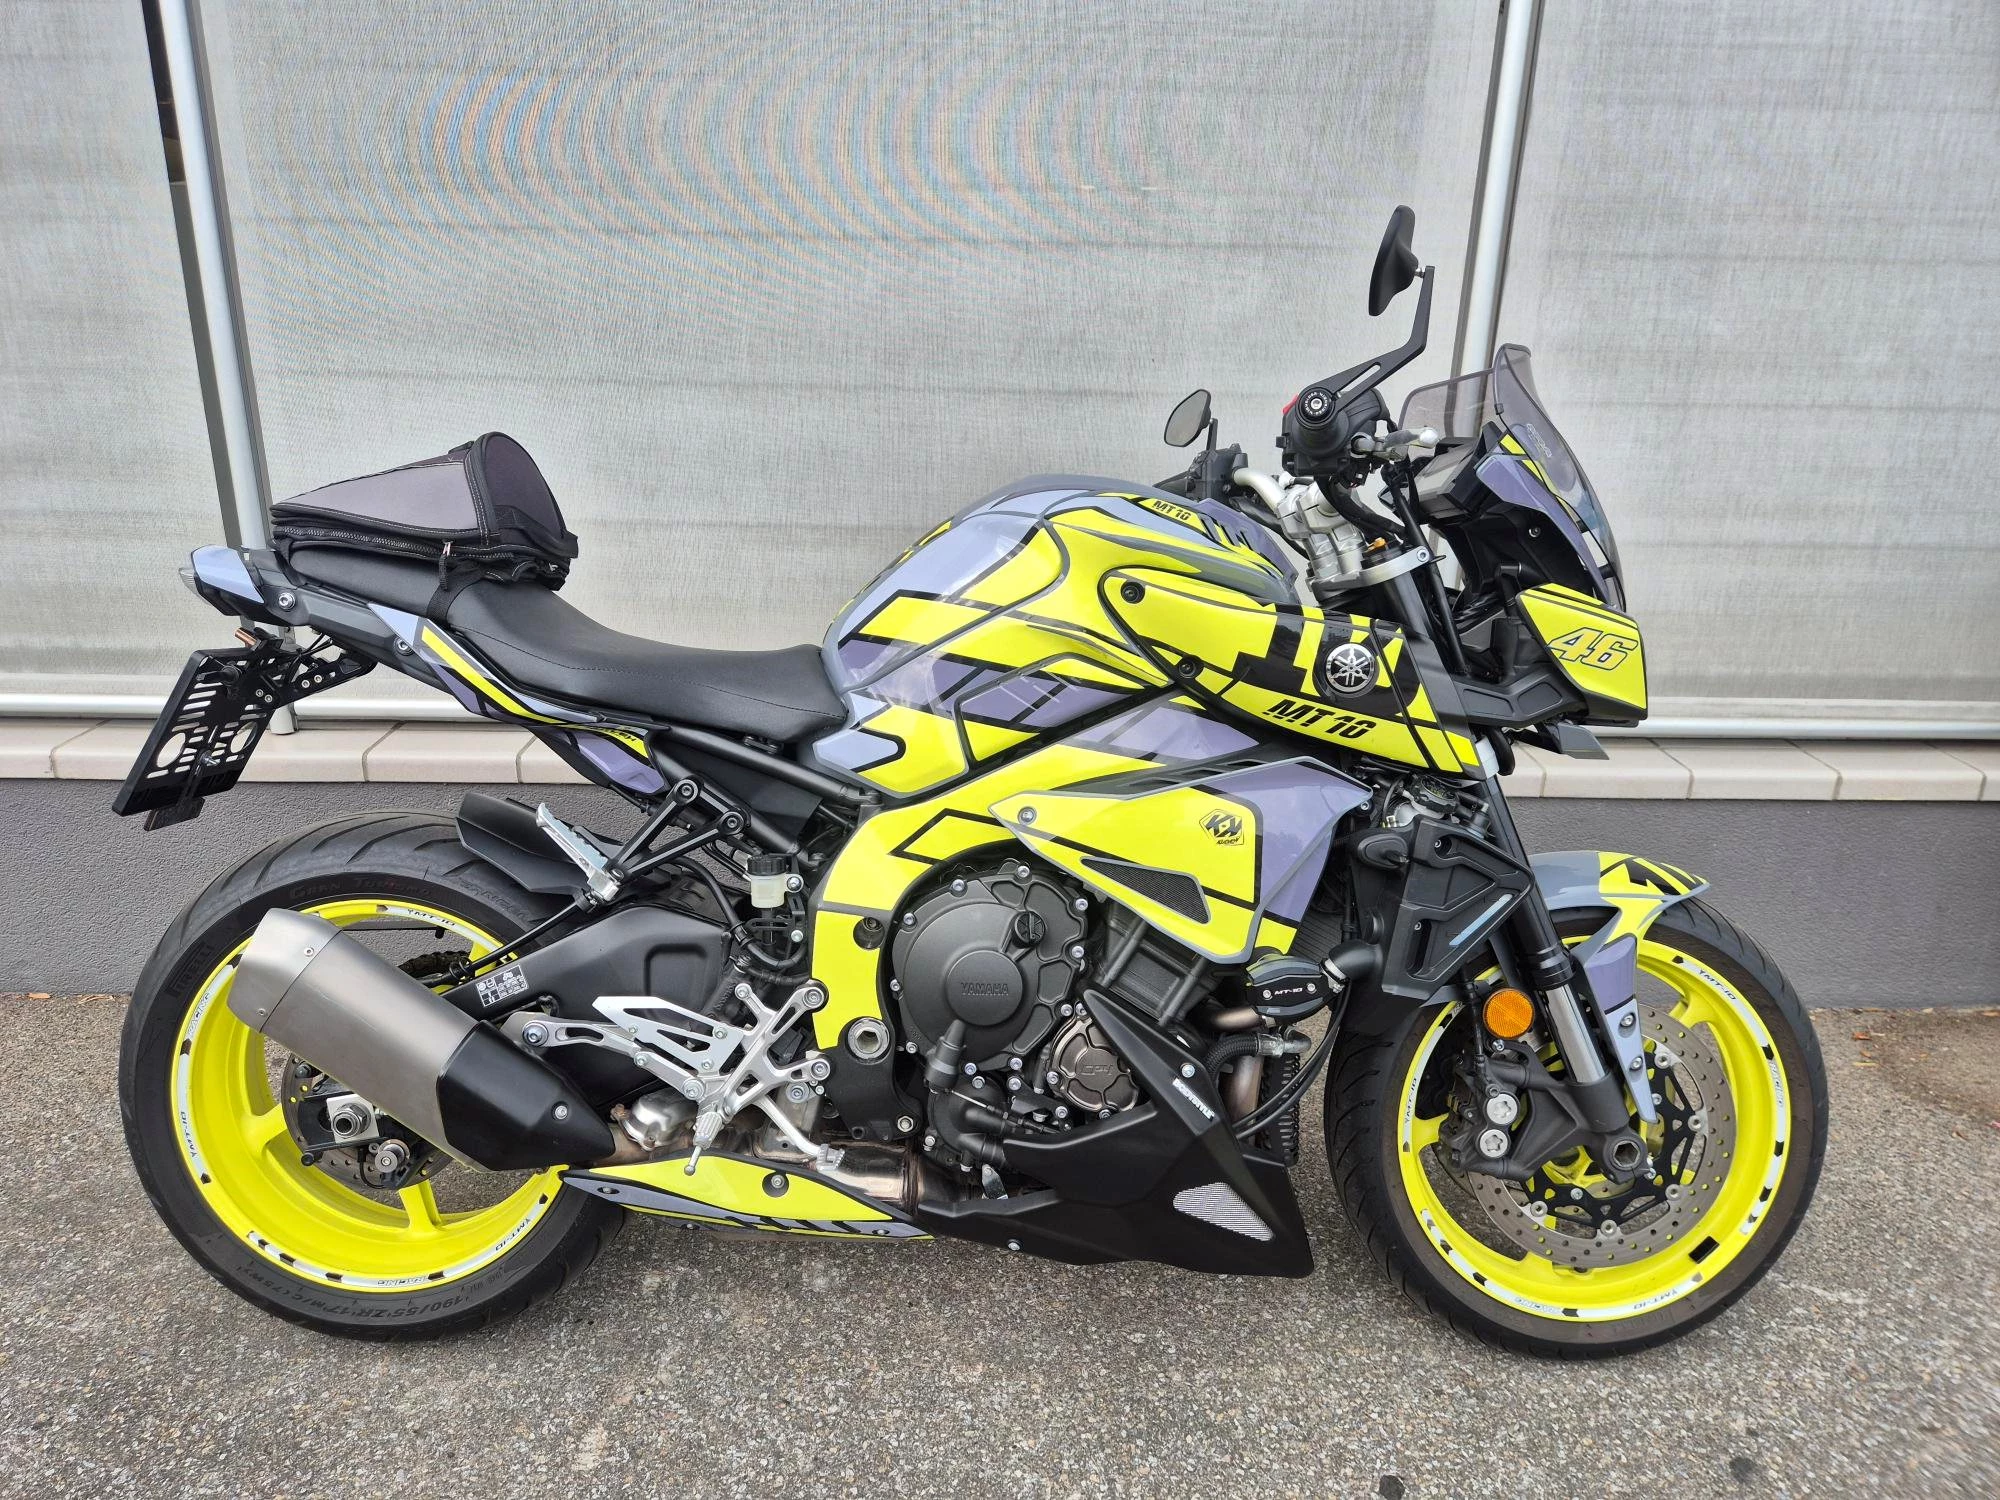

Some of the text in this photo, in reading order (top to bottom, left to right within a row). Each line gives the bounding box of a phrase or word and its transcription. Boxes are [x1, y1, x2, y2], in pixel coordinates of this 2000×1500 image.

[1546, 627, 1639, 671] 46
[1263, 698, 1330, 728] MT
[960, 982, 1009, 996] YAMAHA
[1274, 987, 1303, 996] MT-10
